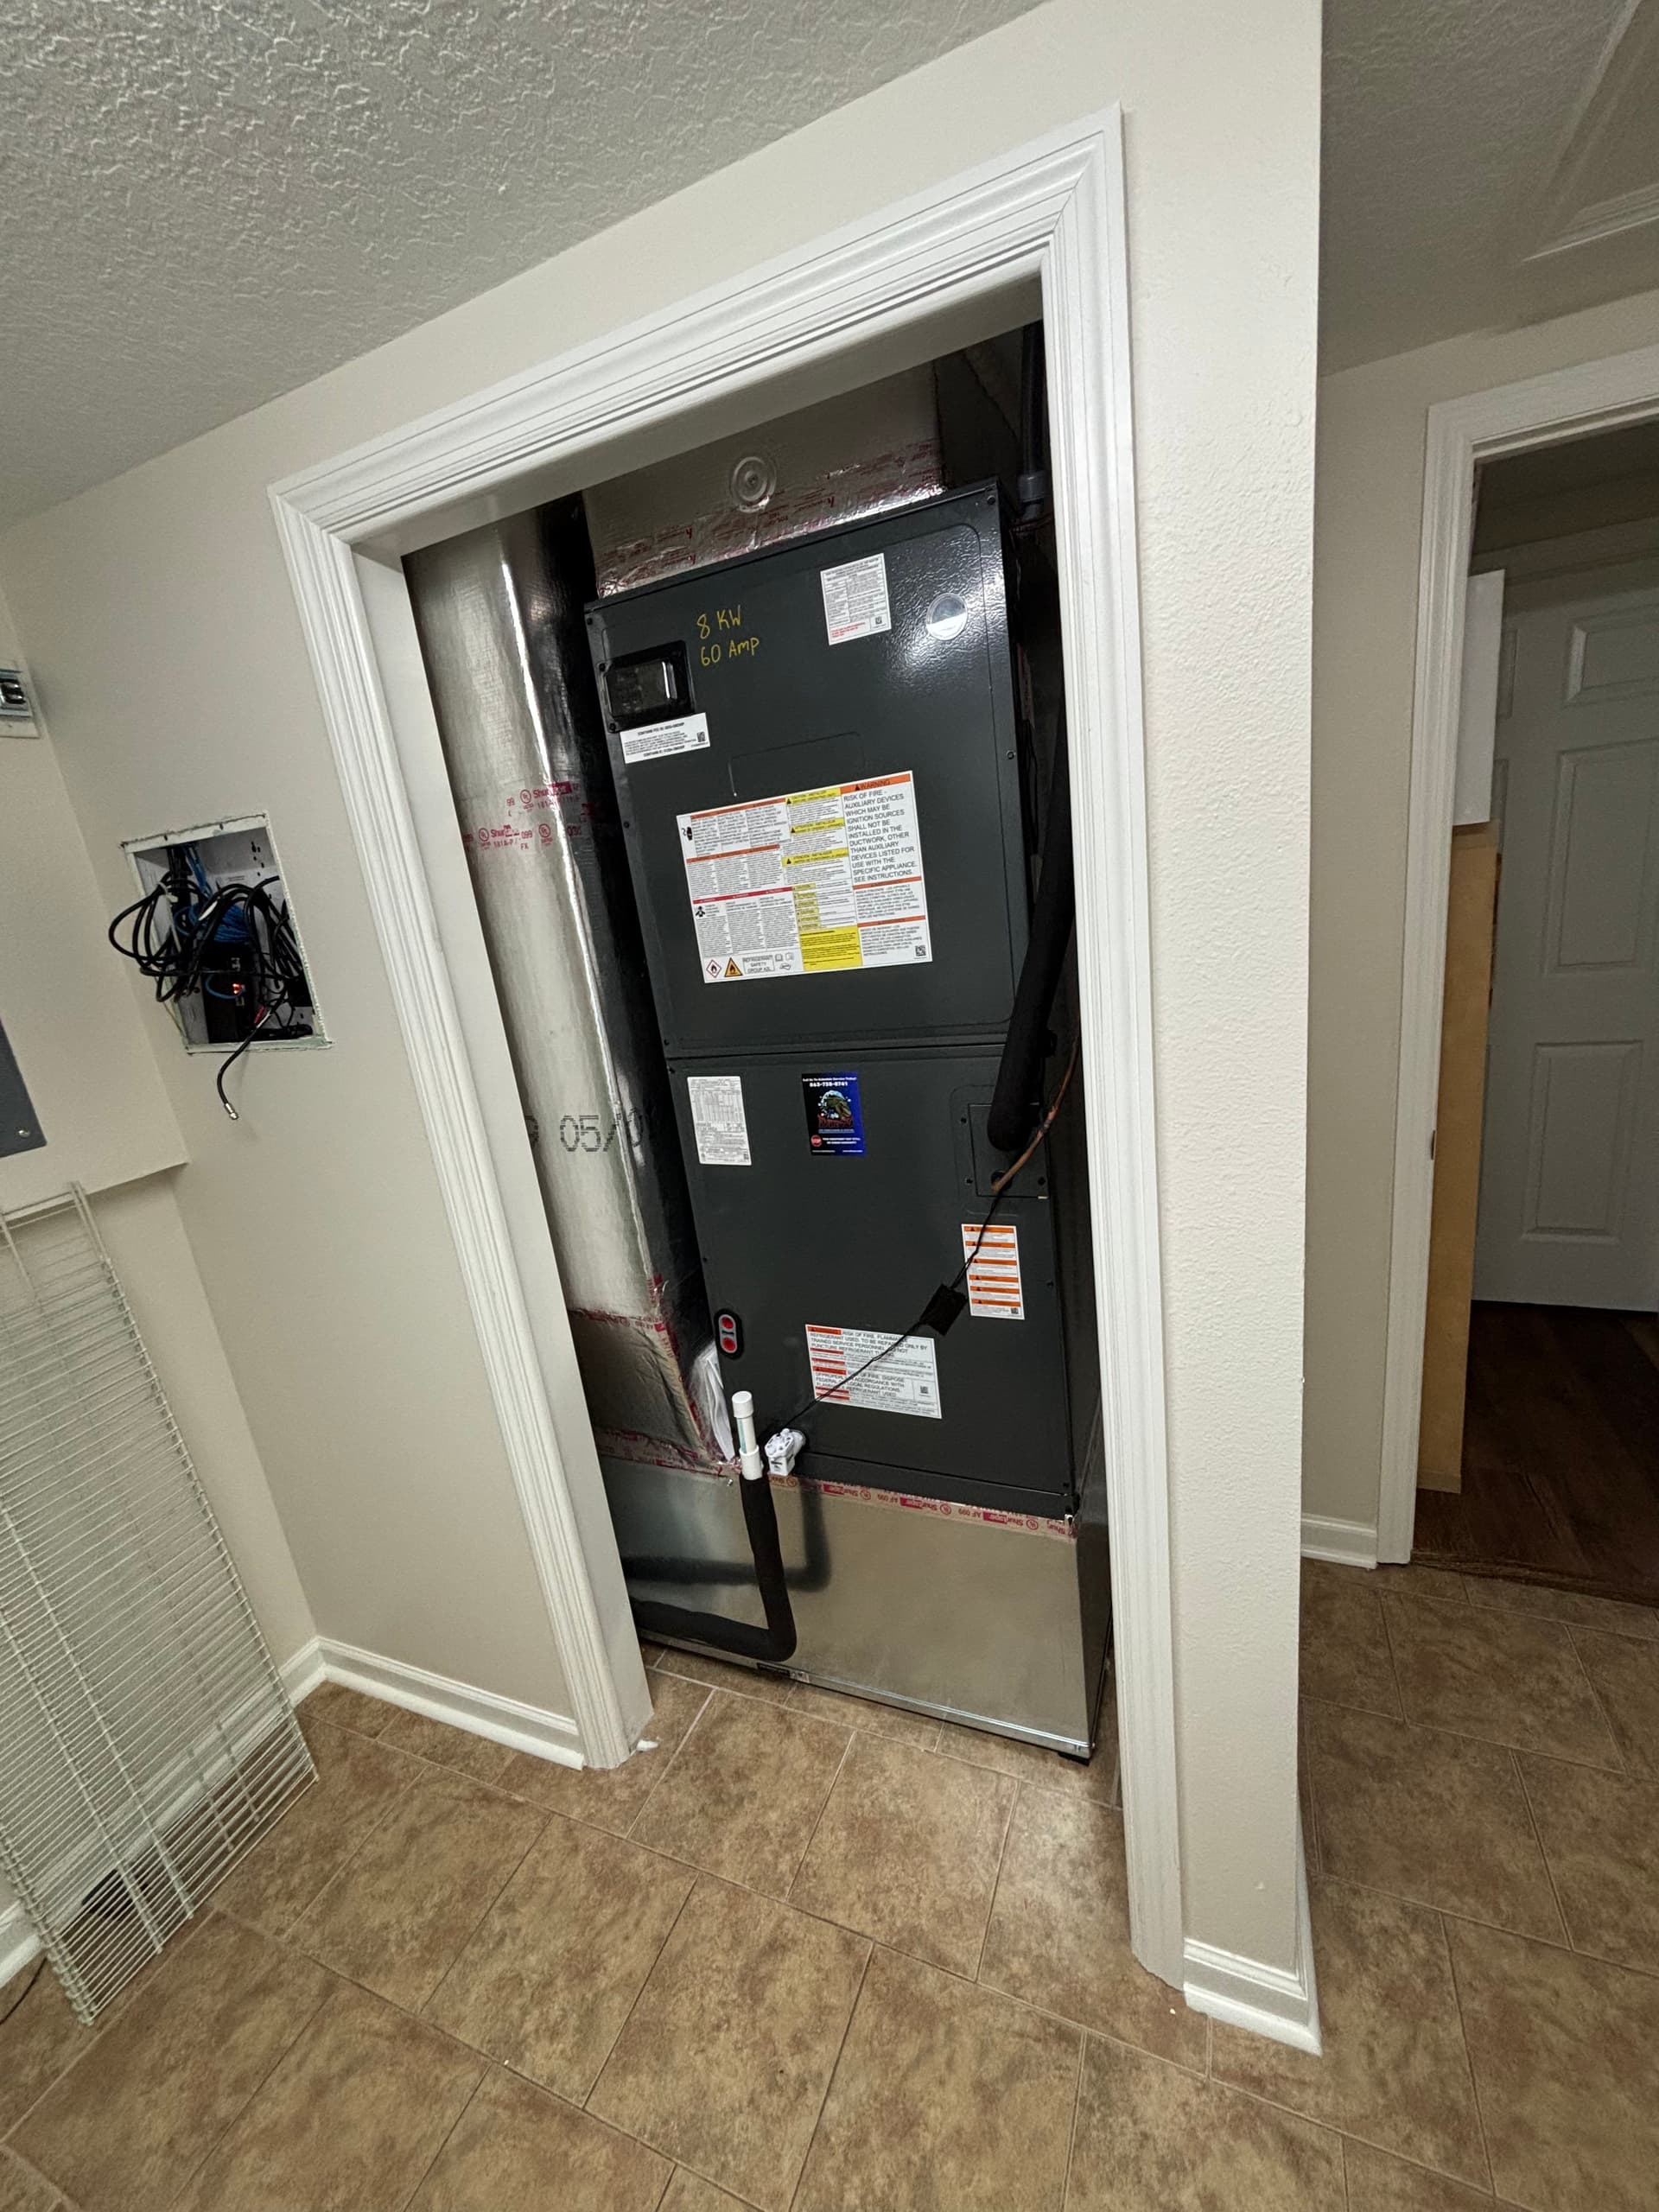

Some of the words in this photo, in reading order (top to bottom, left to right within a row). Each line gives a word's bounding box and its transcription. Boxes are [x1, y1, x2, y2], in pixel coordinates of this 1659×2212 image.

[696, 613, 710, 639] 8
[700, 644, 721, 666] 60
[845, 799, 875, 809] AUXILIARY
[877, 794, 904, 804] DEVICES
[847, 815, 873, 823] IGNITION
[874, 810, 905, 819] SOURCES
[849, 829, 881, 838] INSTALLED
[887, 832, 909, 841] OTHER
[868, 841, 899, 851] AUXILIARY
[852, 853, 877, 861] DEVICES
[853, 867, 880, 875] SPECIFIC
